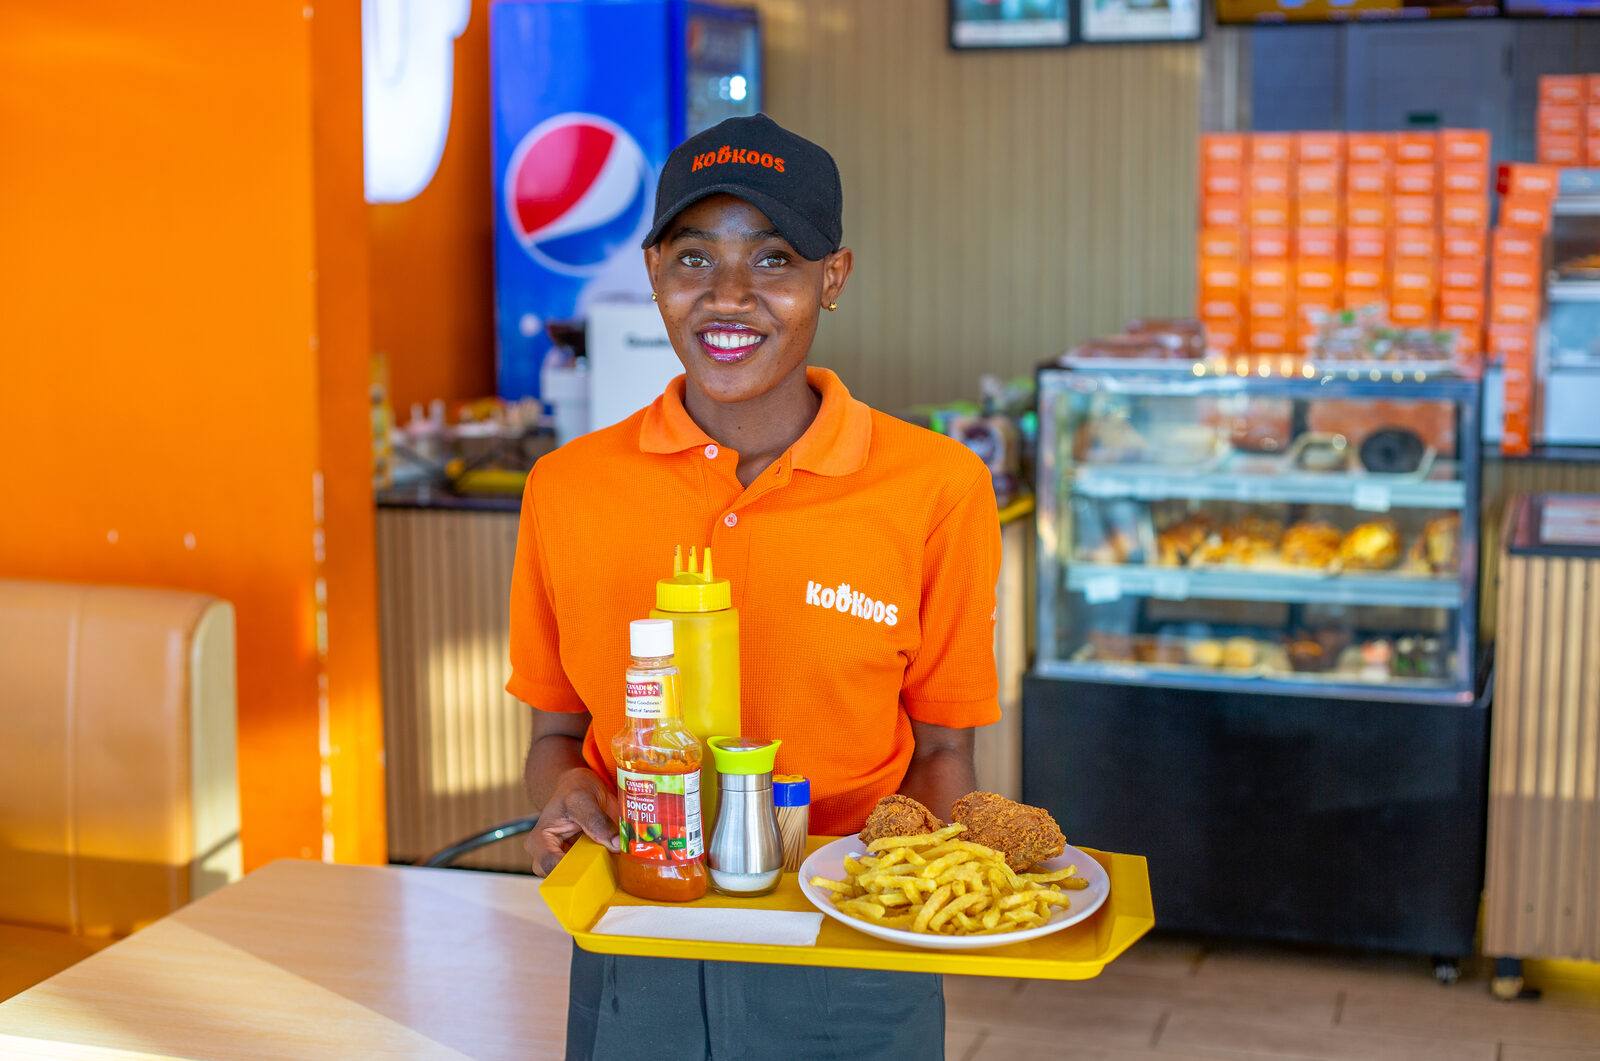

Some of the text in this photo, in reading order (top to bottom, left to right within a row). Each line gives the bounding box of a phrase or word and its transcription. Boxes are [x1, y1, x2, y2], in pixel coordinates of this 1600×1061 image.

[692, 145, 785, 173] KOOKOOS
[806, 581, 898, 626] KOOKOOS
[626, 800, 654, 812] BONGO
[641, 812, 656, 823] PILI
